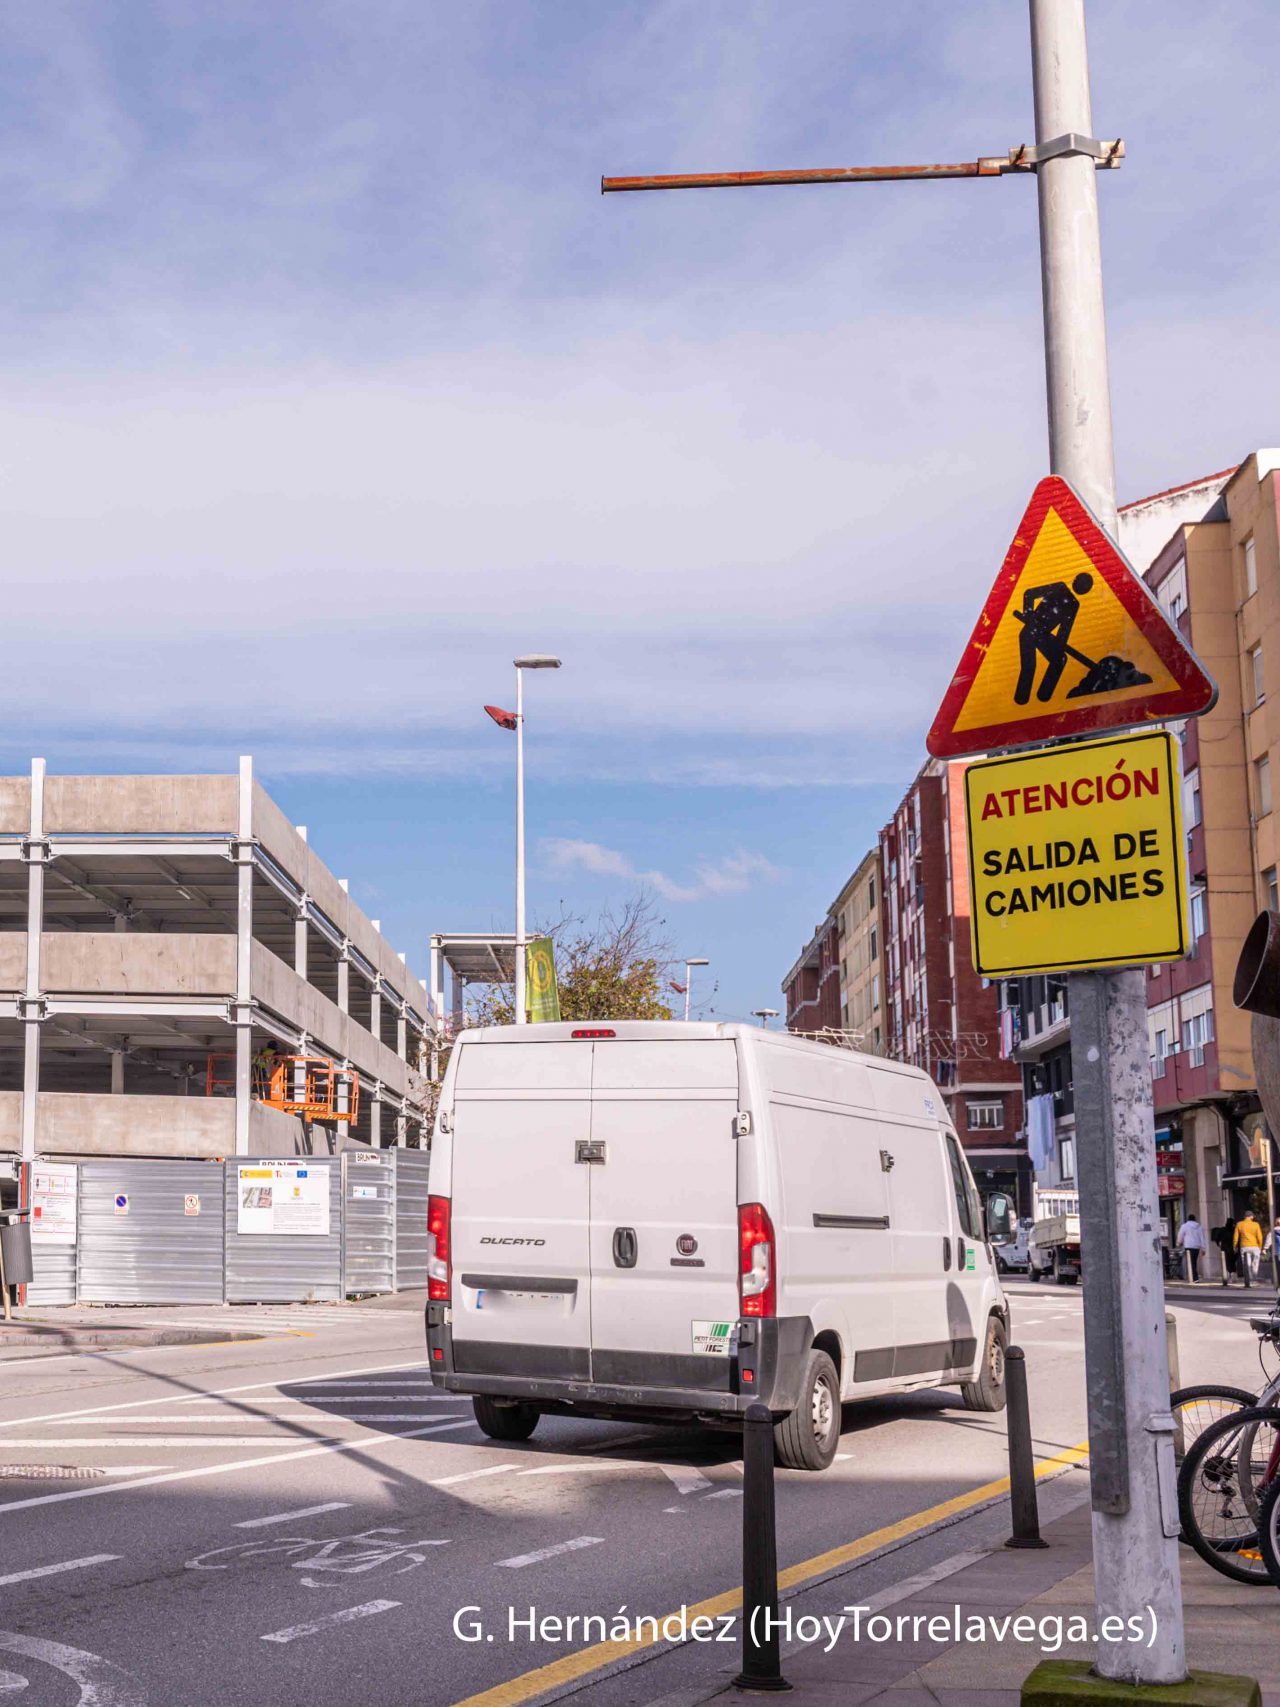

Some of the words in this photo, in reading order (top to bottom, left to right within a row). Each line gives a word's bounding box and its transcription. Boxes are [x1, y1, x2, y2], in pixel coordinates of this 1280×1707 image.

[981, 758, 1160, 821] ATENCIÓN
[982, 837, 1100, 877] SALIDA
[1113, 829, 1160, 861] DE
[985, 869, 1165, 917] CAMIONES
[479, 1237, 546, 1246] DUCATO
[681, 1239, 693, 1250] FIAT
